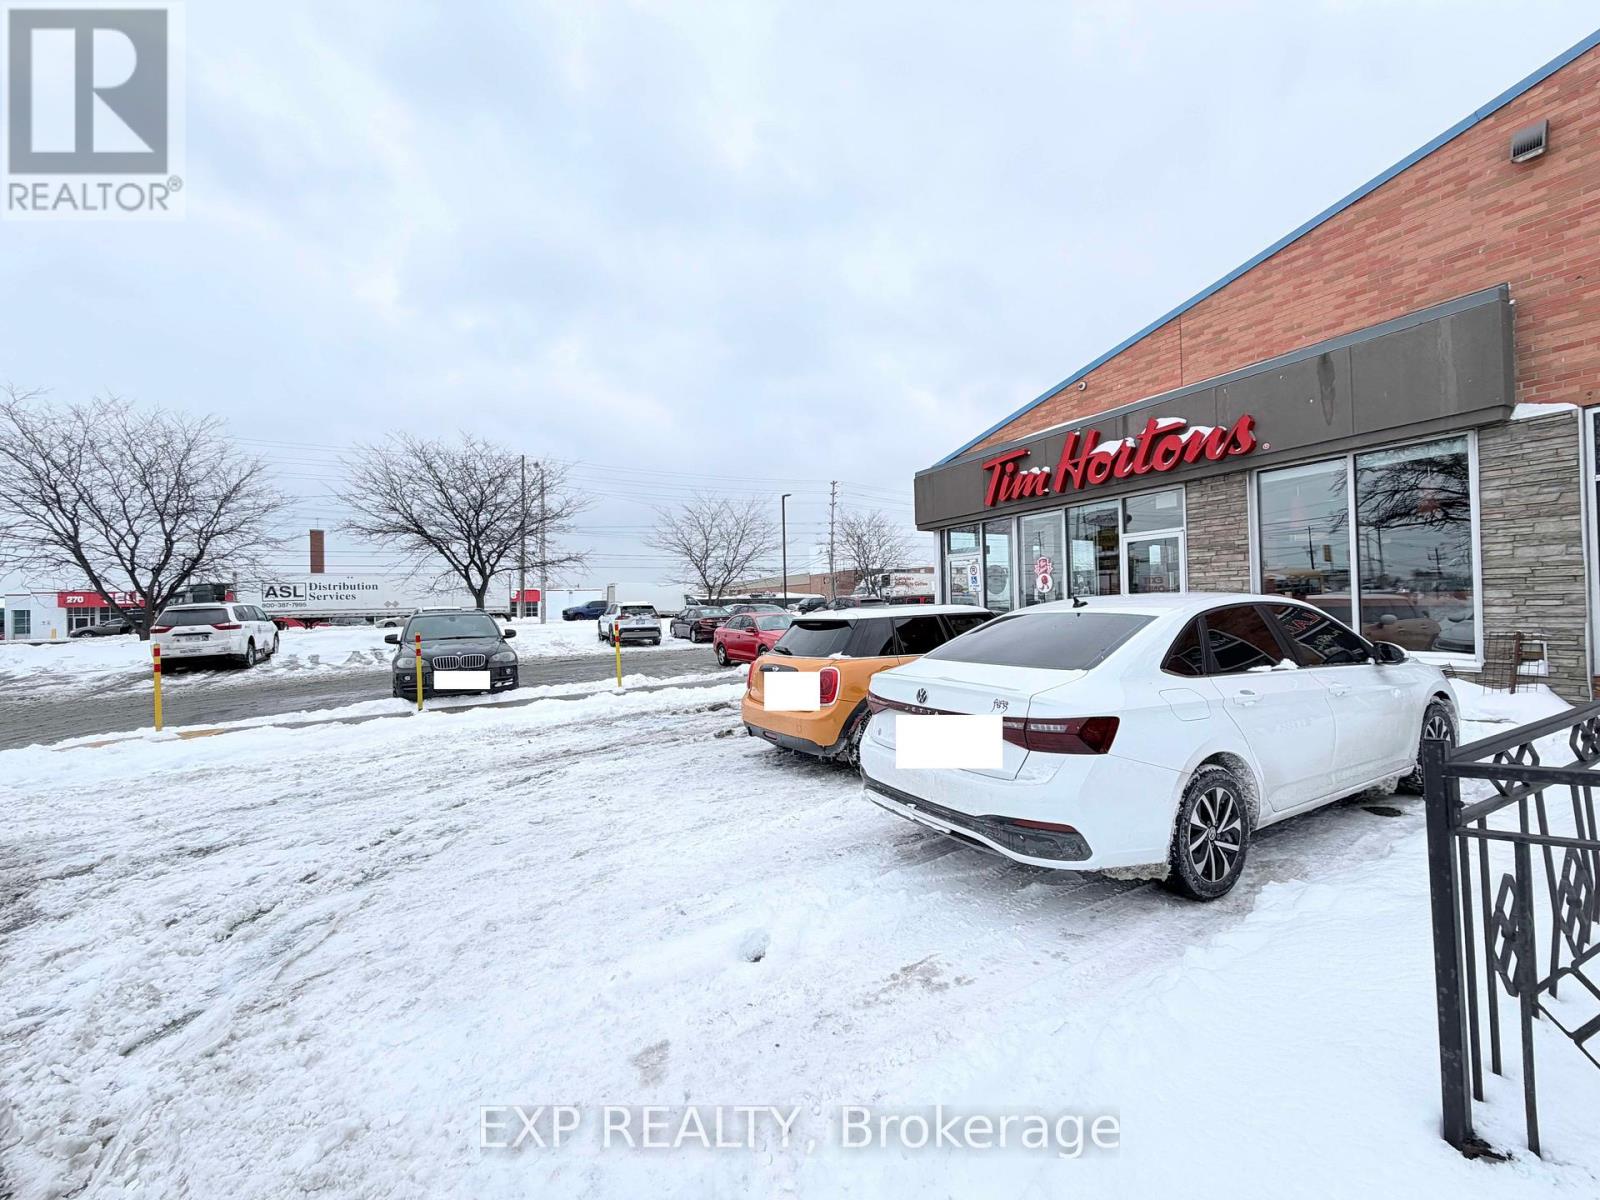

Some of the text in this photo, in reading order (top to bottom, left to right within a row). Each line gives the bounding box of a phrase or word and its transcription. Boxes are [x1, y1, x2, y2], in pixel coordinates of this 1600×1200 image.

[982, 414, 1257, 507] Tim Hortons
[308, 582, 379, 591] Distribution
[264, 585, 305, 598] ASL
[66, 596, 84, 604] 270
[308, 592, 357, 601] Services
